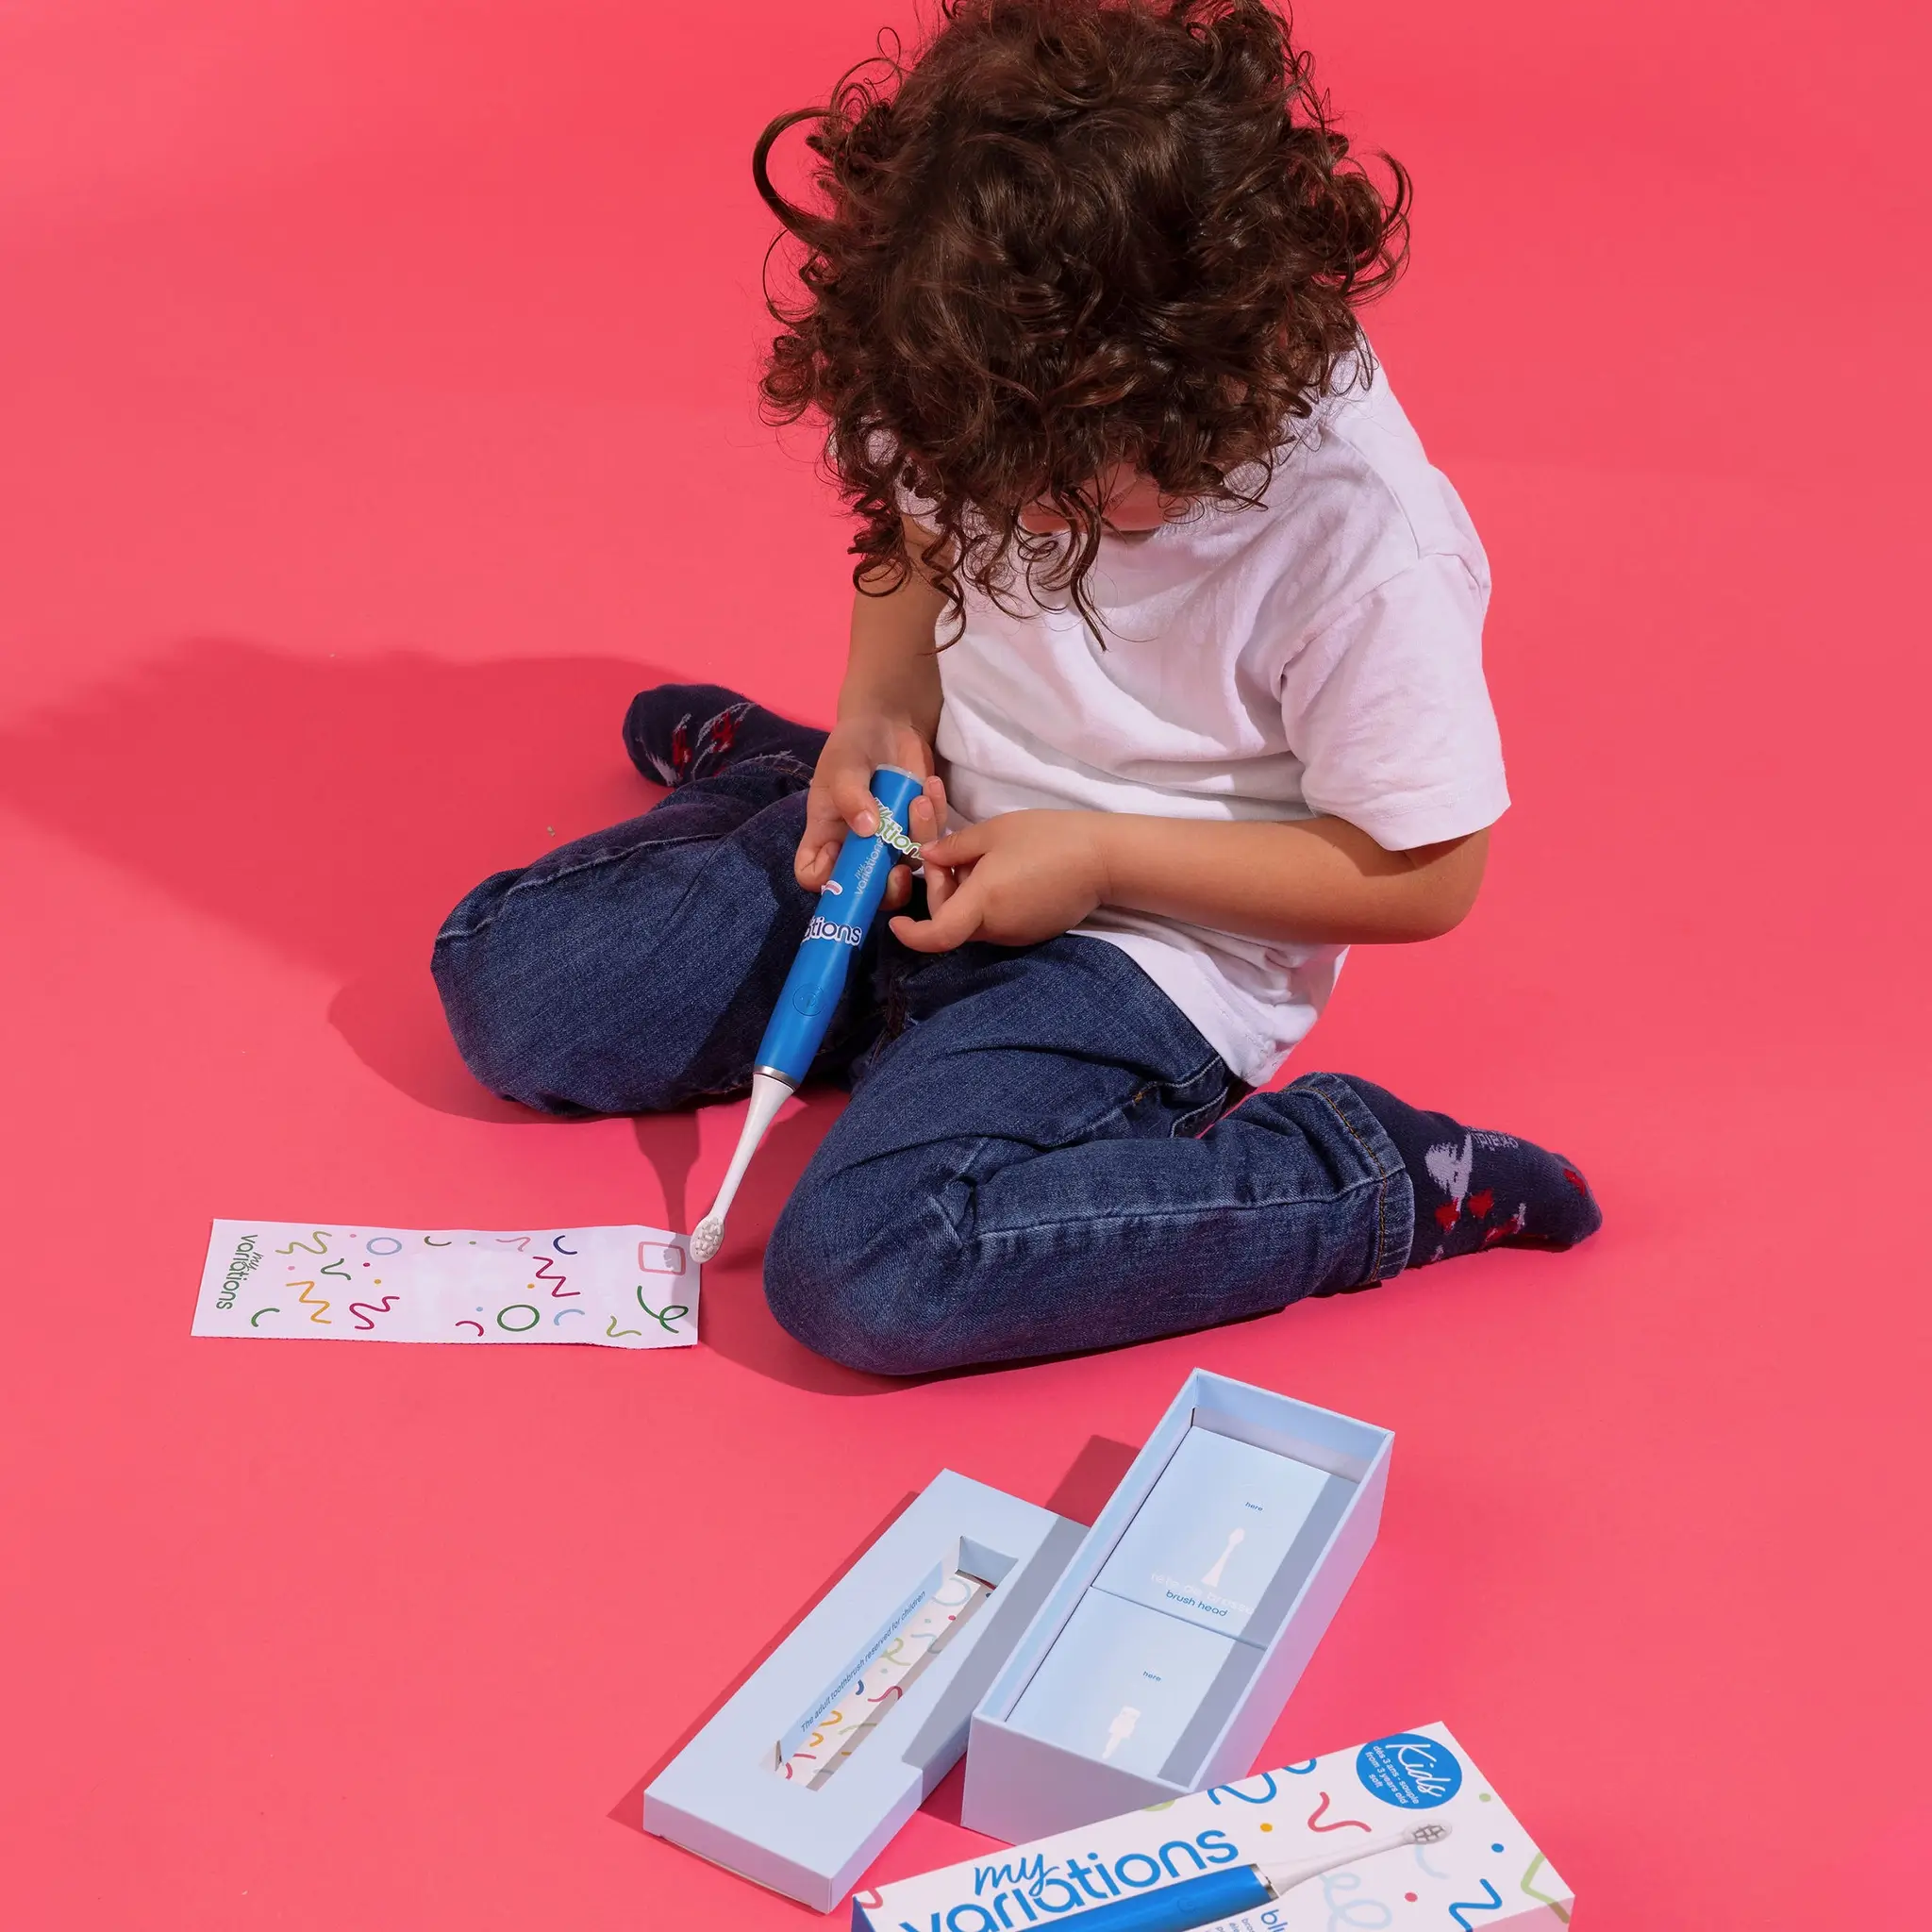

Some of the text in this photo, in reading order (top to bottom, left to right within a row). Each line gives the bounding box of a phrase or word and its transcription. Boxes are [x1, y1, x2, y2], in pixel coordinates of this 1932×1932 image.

[855, 837, 884, 895] variations
[216, 1235, 258, 1309] variations
[241, 1252, 264, 1271] my
[1245, 1501, 1263, 1512] here
[1166, 1590, 1229, 1617] brush head
[801, 1591, 926, 1732] The adult toothbrush reserved for children
[1142, 1670, 1162, 1682] here
[1365, 1751, 1380, 1771] from
[1379, 1773, 1398, 1793] years
[1394, 1790, 1408, 1805] old
[1369, 1774, 1384, 1789] soft
[1385, 1743, 1452, 1797] Kids
[1387, 1763, 1399, 1777] ans
[1399, 1780, 1420, 1805] souple
[897, 1829, 1240, 1932] variations
[974, 1853, 1060, 1896] my
[1260, 1908, 1288, 1932] bl
